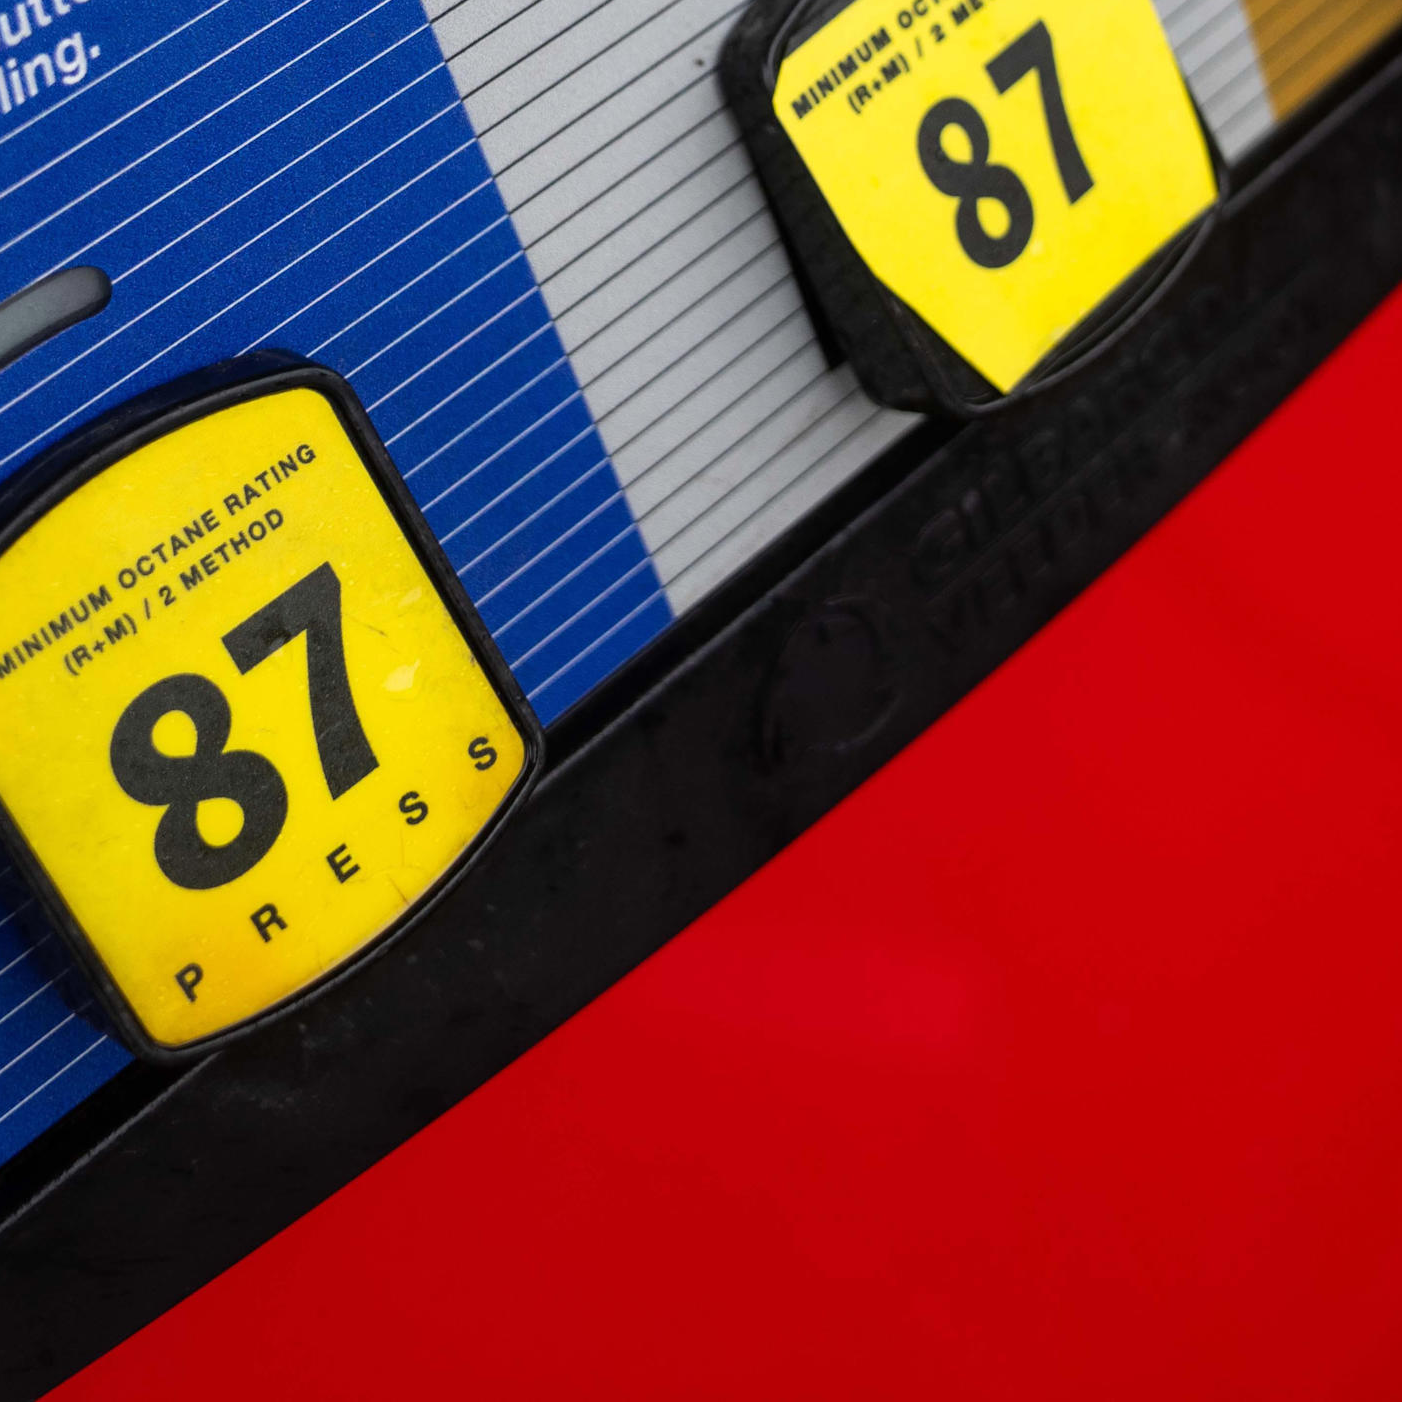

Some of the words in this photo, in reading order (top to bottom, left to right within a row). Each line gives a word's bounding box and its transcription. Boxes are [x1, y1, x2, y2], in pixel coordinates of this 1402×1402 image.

[791, 27, 892, 120] MINIMUM
[848, 53, 911, 115] (R+M)
[930, 23, 946, 43] 2
[917, 19, 1095, 270] 87
[64, 613, 138, 676] (R+M)
[158, 585, 177, 606] 2
[179, 508, 284, 590] METHOD
[118, 509, 221, 589] OCTANE
[222, 443, 317, 516] RATING
[110, 561, 379, 891] 87
